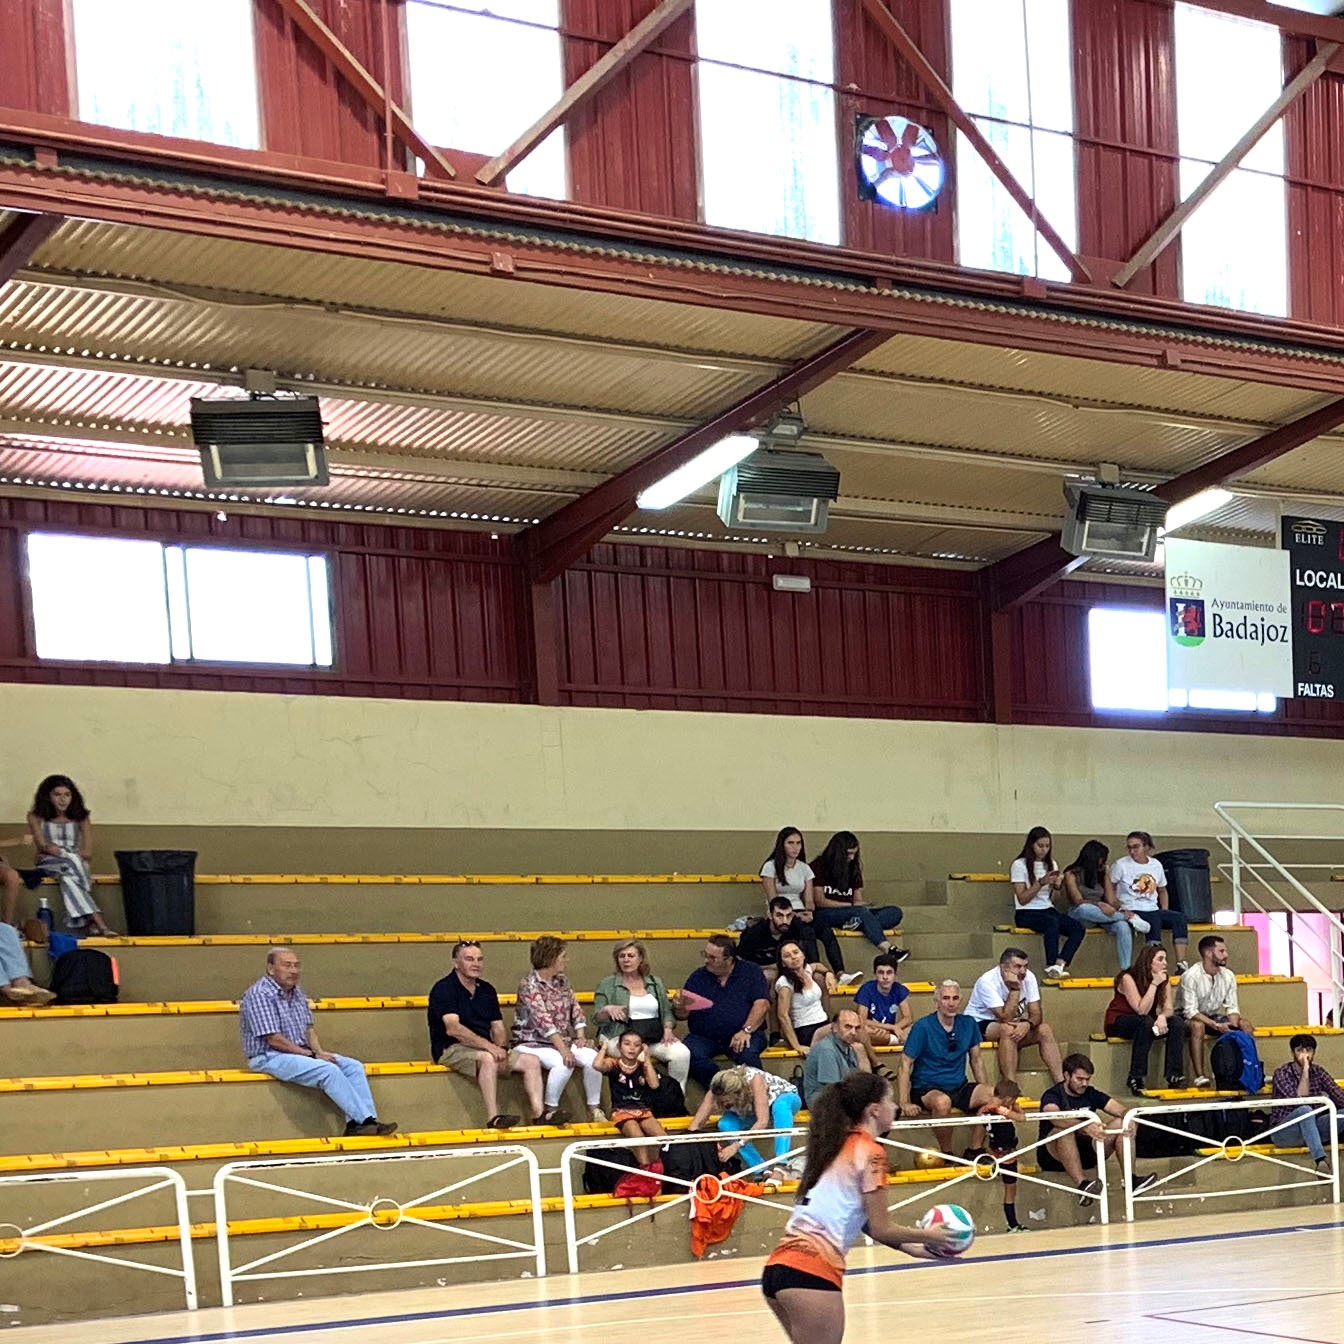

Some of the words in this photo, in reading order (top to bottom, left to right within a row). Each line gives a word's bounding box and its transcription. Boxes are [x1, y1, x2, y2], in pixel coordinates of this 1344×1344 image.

[1295, 533, 1325, 545] ELITE
[1211, 598, 1274, 612] Ayuntamiento
[1277, 603, 1287, 613] de
[1212, 613, 1288, 646] Badajoz
[1297, 682, 1334, 698] FALTAS
